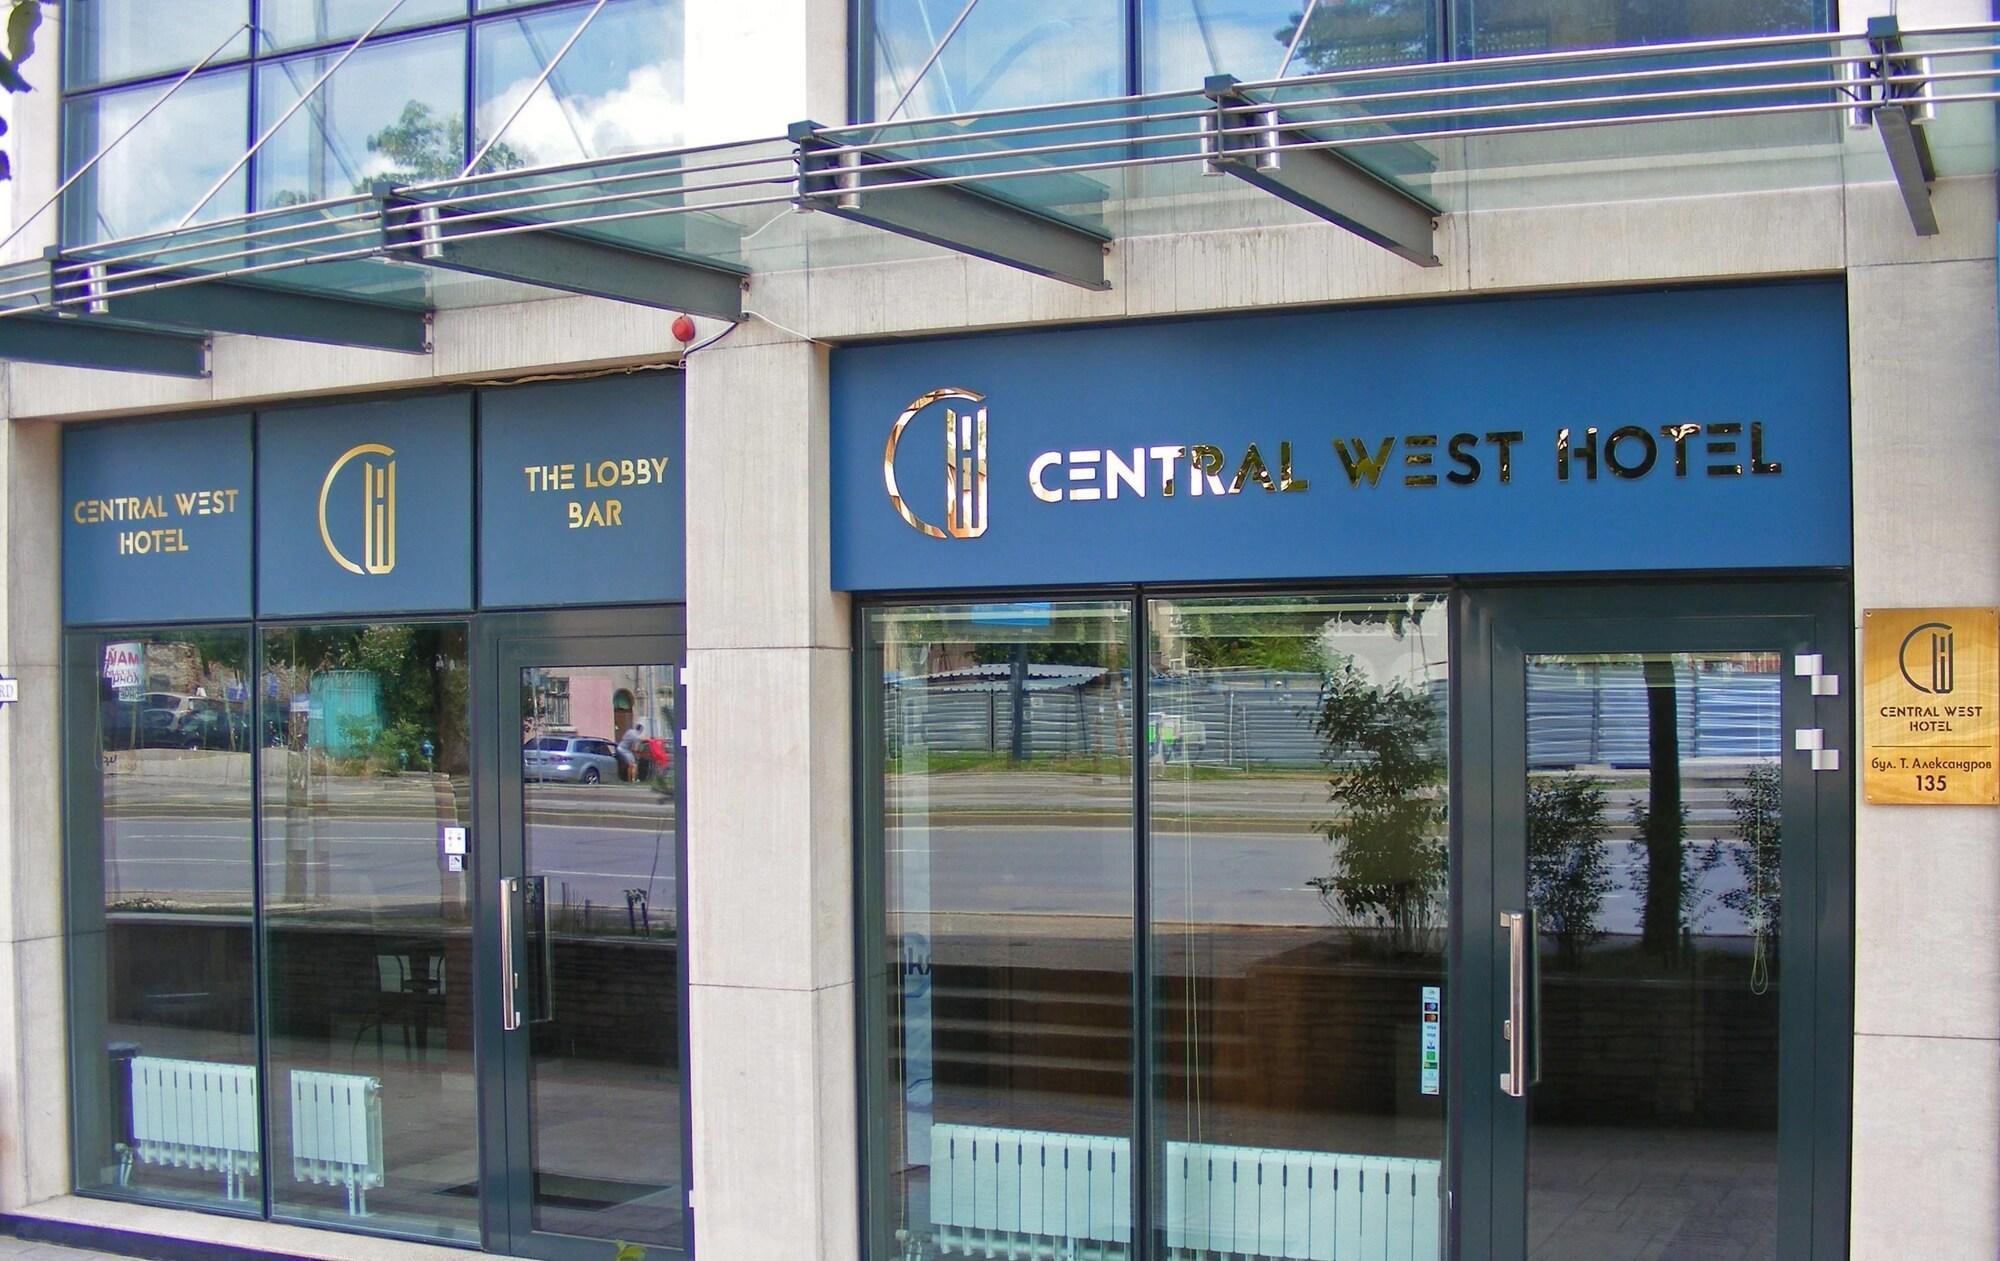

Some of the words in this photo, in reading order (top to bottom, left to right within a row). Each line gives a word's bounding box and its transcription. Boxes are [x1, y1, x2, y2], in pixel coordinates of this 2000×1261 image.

[524, 464, 575, 492] THE
[585, 457, 669, 488] LOBBY
[1028, 441, 1309, 503] CENTRAL
[1332, 431, 1524, 489] WEST
[1557, 421, 1782, 480] HOTEL
[74, 495, 168, 524] CENTRAL
[175, 489, 239, 516] WEST
[568, 499, 623, 529] BAR
[120, 529, 189, 555] HOTEL
[1880, 706, 1939, 717] CENTRAL
[1945, 706, 1983, 717] WEST
[1909, 721, 1953, 732] HOTEL
[1871, 757, 1896, 772] бул.
[1900, 758, 1909, 769] Т.
[1912, 757, 1992, 772] Александров
[1916, 775, 1947, 791] 135
